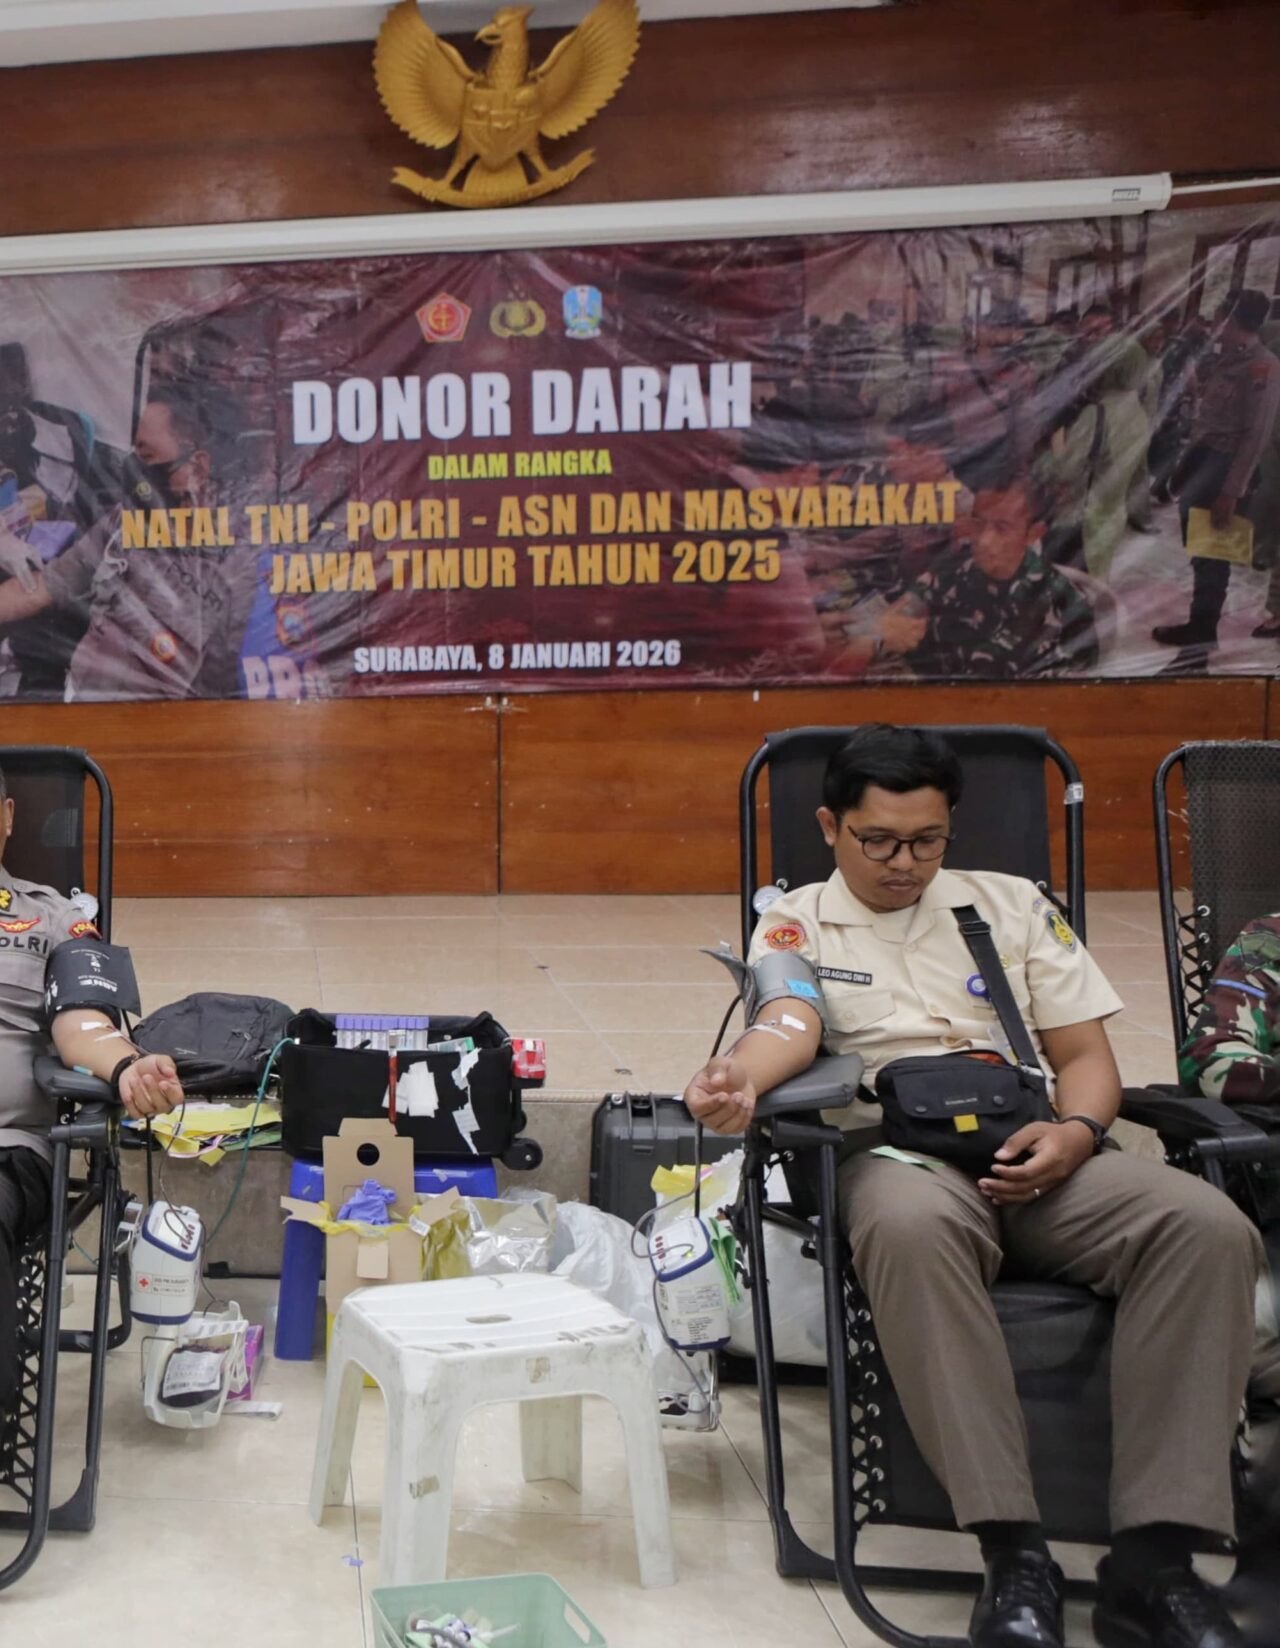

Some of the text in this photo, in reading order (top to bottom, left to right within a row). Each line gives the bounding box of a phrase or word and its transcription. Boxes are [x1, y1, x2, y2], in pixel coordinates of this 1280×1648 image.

[292, 361, 752, 445] DONOR DARAH
[427, 449, 612, 480] DALAM RANGKA
[121, 506, 235, 549] NATAL
[245, 503, 310, 545] TNI
[346, 497, 461, 542] POLRI
[497, 494, 578, 538] ASN
[590, 491, 671, 534] DAN
[684, 482, 962, 531] MASYARAKAT
[270, 538, 781, 594] JAWA TIMUR TAHUN 2025
[354, 640, 681, 673] SURABAYA, 8 JANUARI 2026
